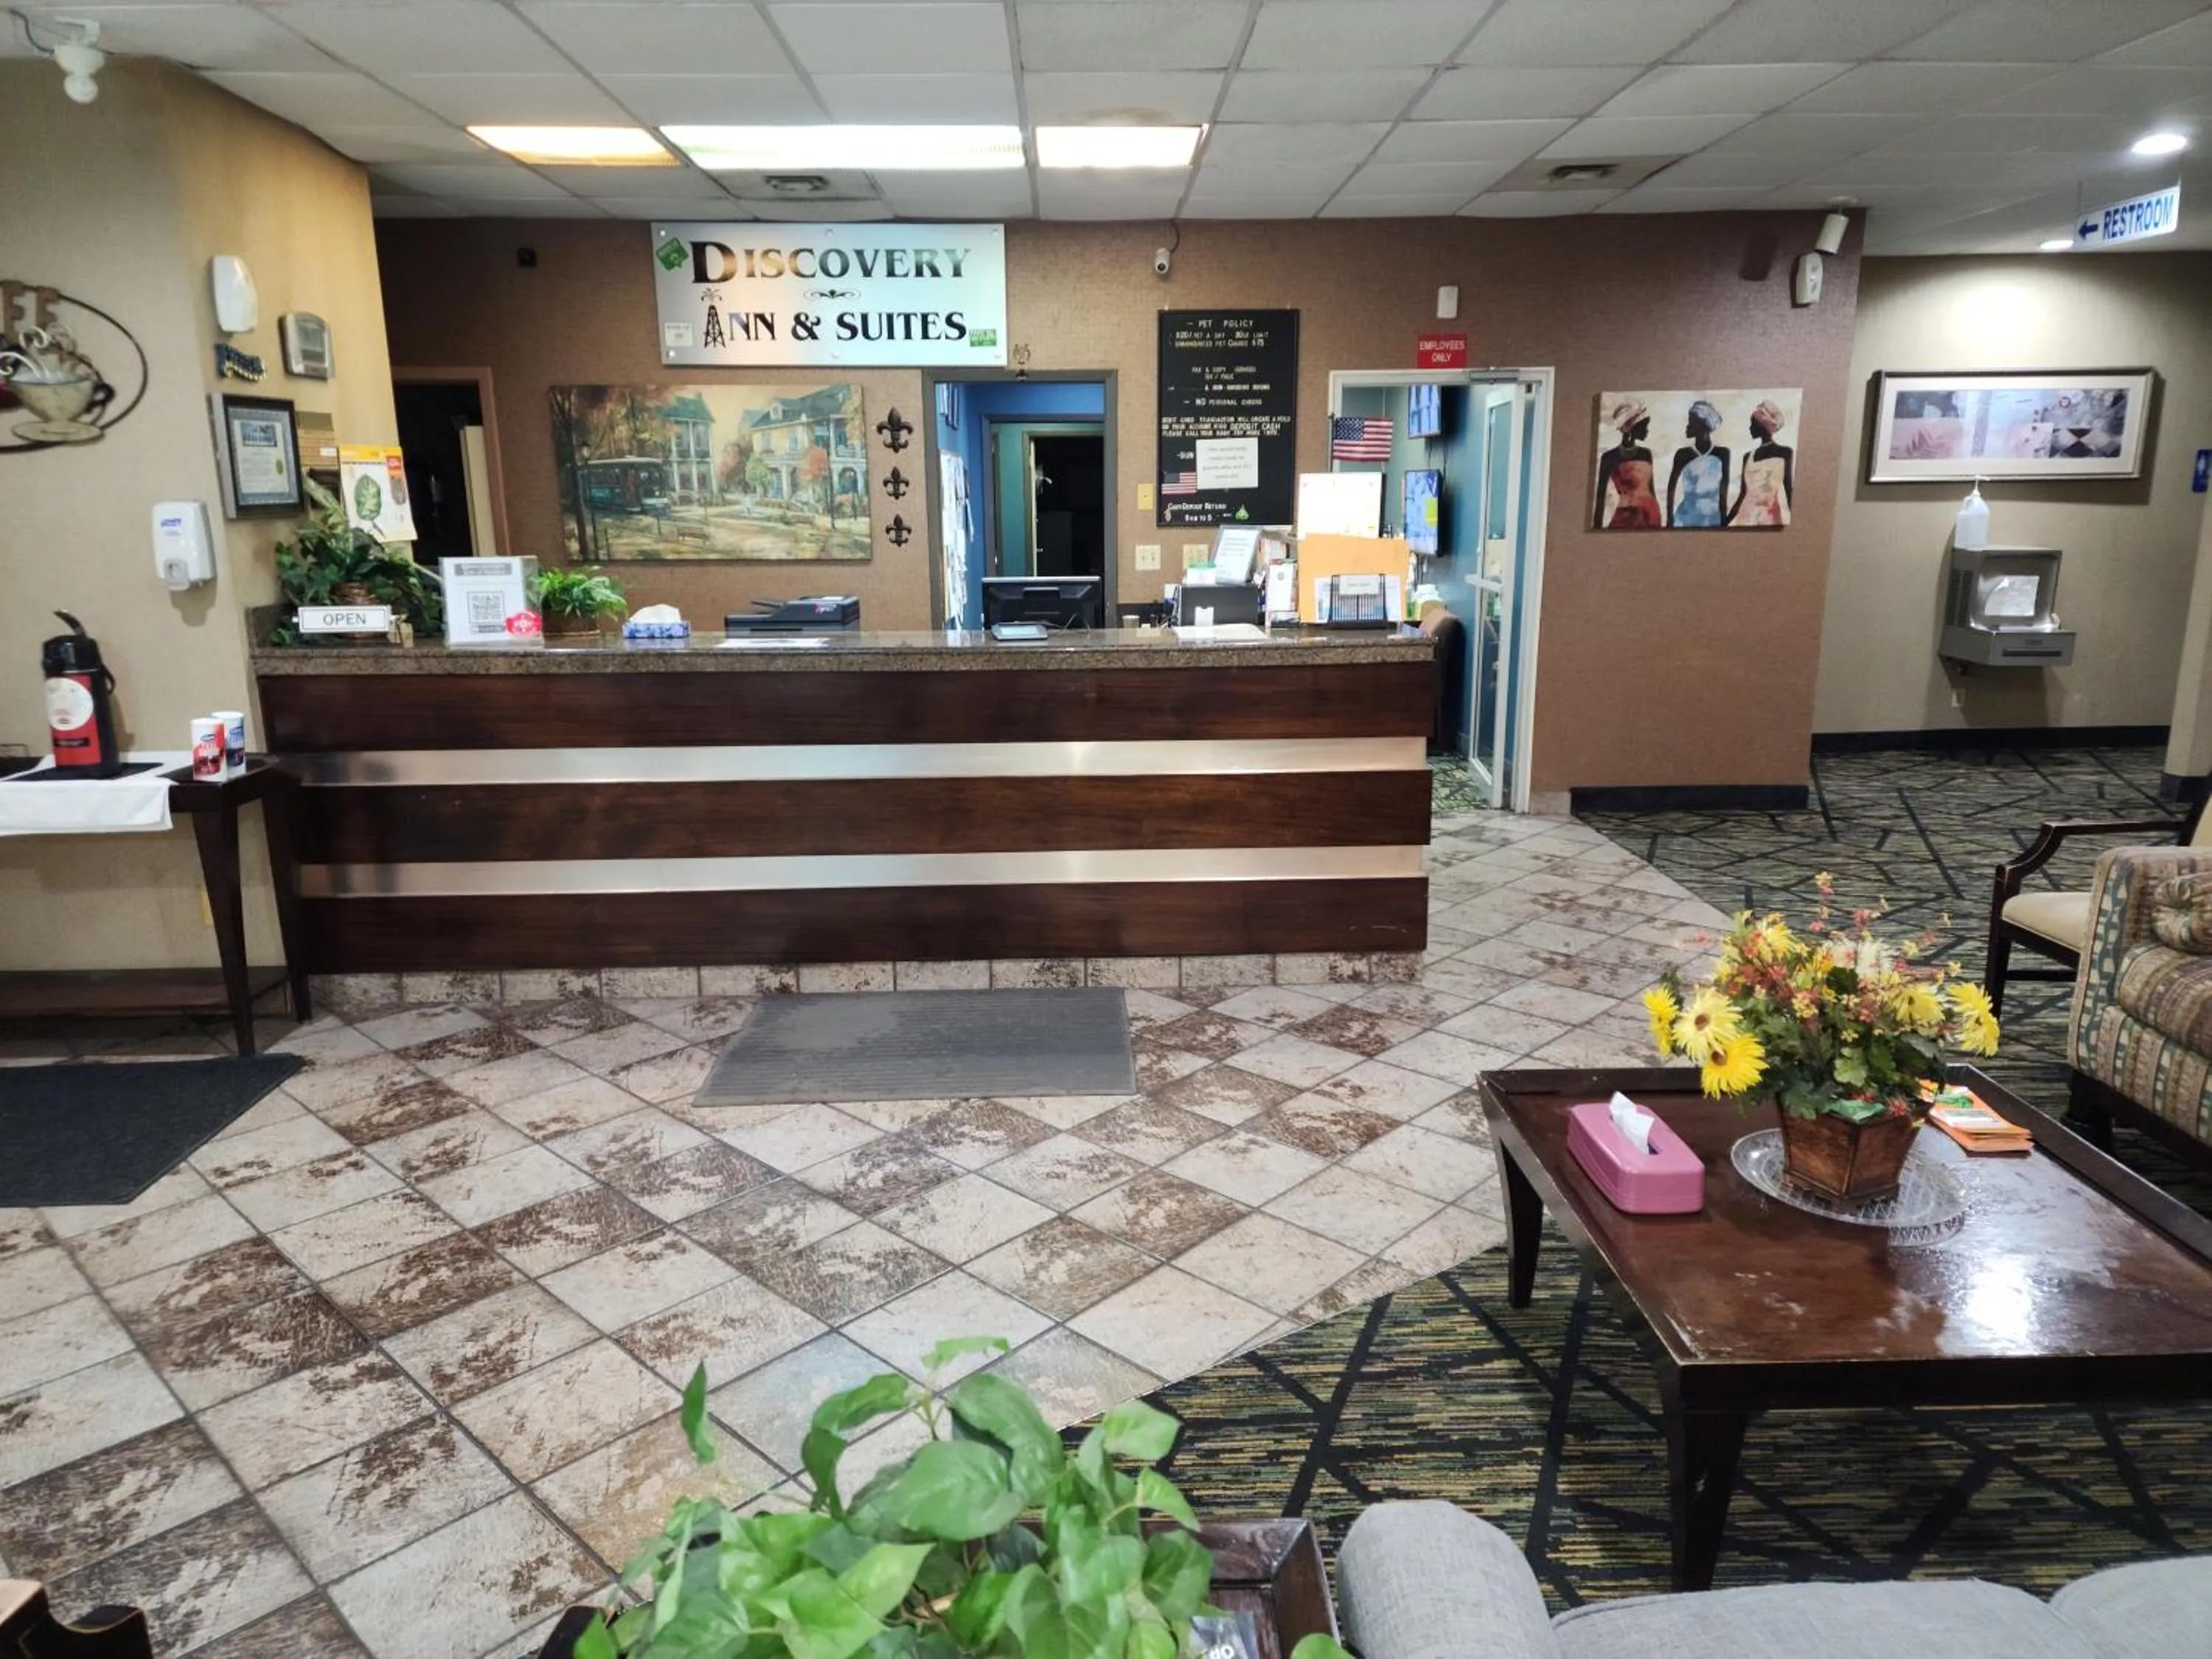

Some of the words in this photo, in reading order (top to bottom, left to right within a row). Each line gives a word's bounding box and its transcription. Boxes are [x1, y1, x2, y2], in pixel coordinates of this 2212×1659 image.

[2102, 194, 2174, 240] RESTROOM
[689, 240, 972, 284] DISCOVERY
[791, 312, 821, 342] &
[836, 311, 967, 342] SUITES
[1198, 319, 1213, 329] PET
[1222, 319, 1254, 329] POLICY
[1419, 340, 1466, 350] EMPLOYEES
[1431, 351, 1452, 363] ONLY
[1229, 422, 1259, 431] DEPOSIT
[1262, 422, 1281, 431] CASH
[322, 613, 367, 626] OPEN
